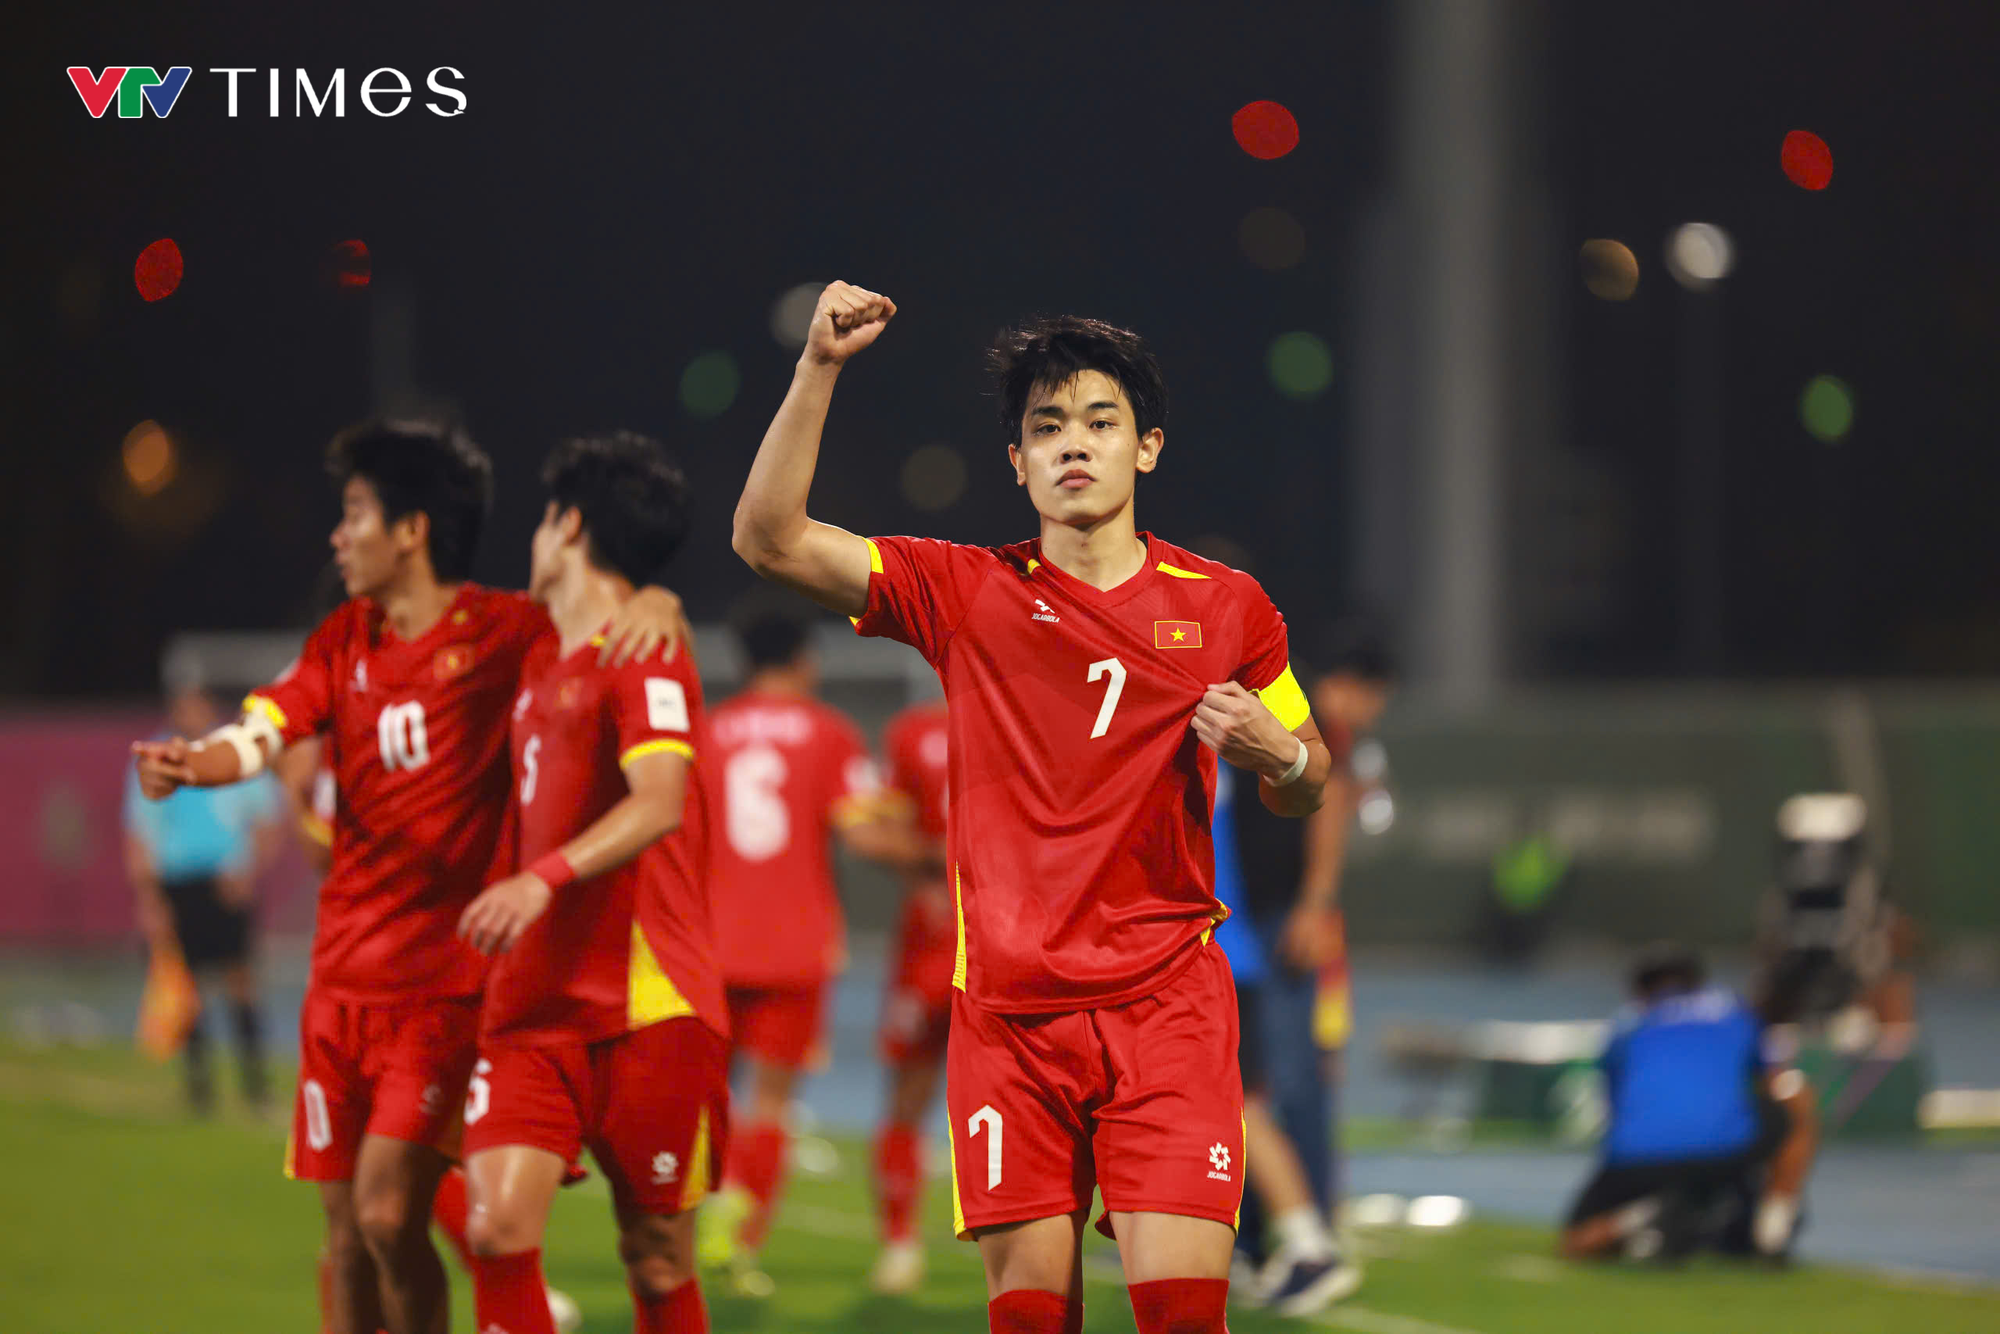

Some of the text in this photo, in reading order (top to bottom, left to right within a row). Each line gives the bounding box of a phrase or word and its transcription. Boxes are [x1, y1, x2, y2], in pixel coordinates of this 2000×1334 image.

[378, 700, 430, 773] 10
[1086, 657, 1127, 739] 7
[724, 745, 790, 860] 6
[968, 1104, 1003, 1191] 7
